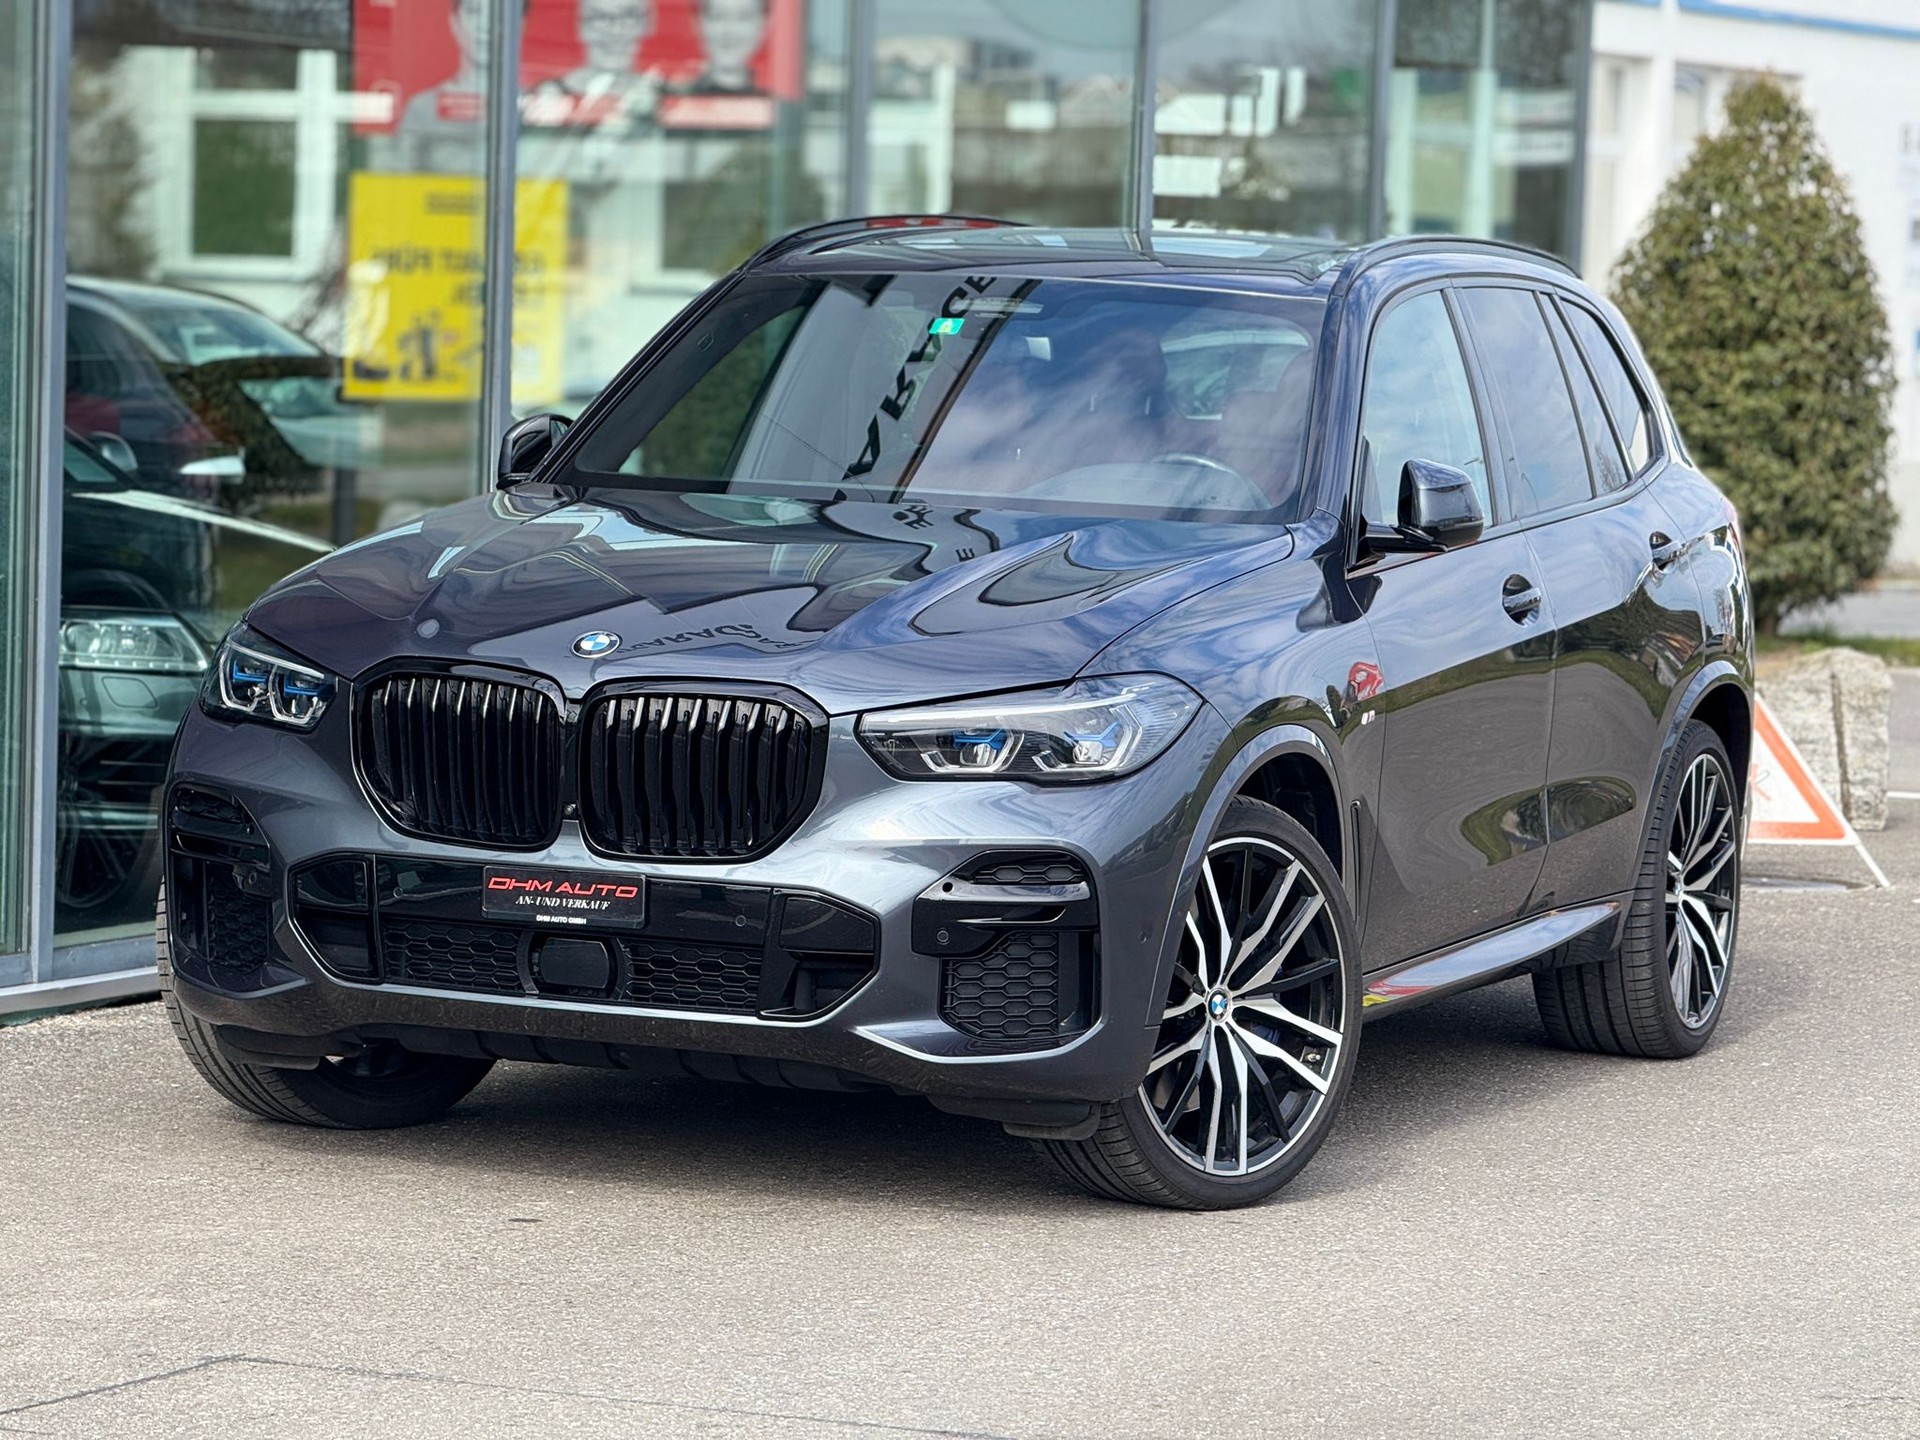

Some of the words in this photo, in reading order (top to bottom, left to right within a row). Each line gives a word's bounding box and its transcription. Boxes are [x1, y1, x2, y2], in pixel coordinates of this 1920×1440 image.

[555, 882, 638, 898] AUTO
[515, 895, 534, 905] AN-
[536, 897, 560, 907] UND
[562, 898, 611, 910] VERKAUF
